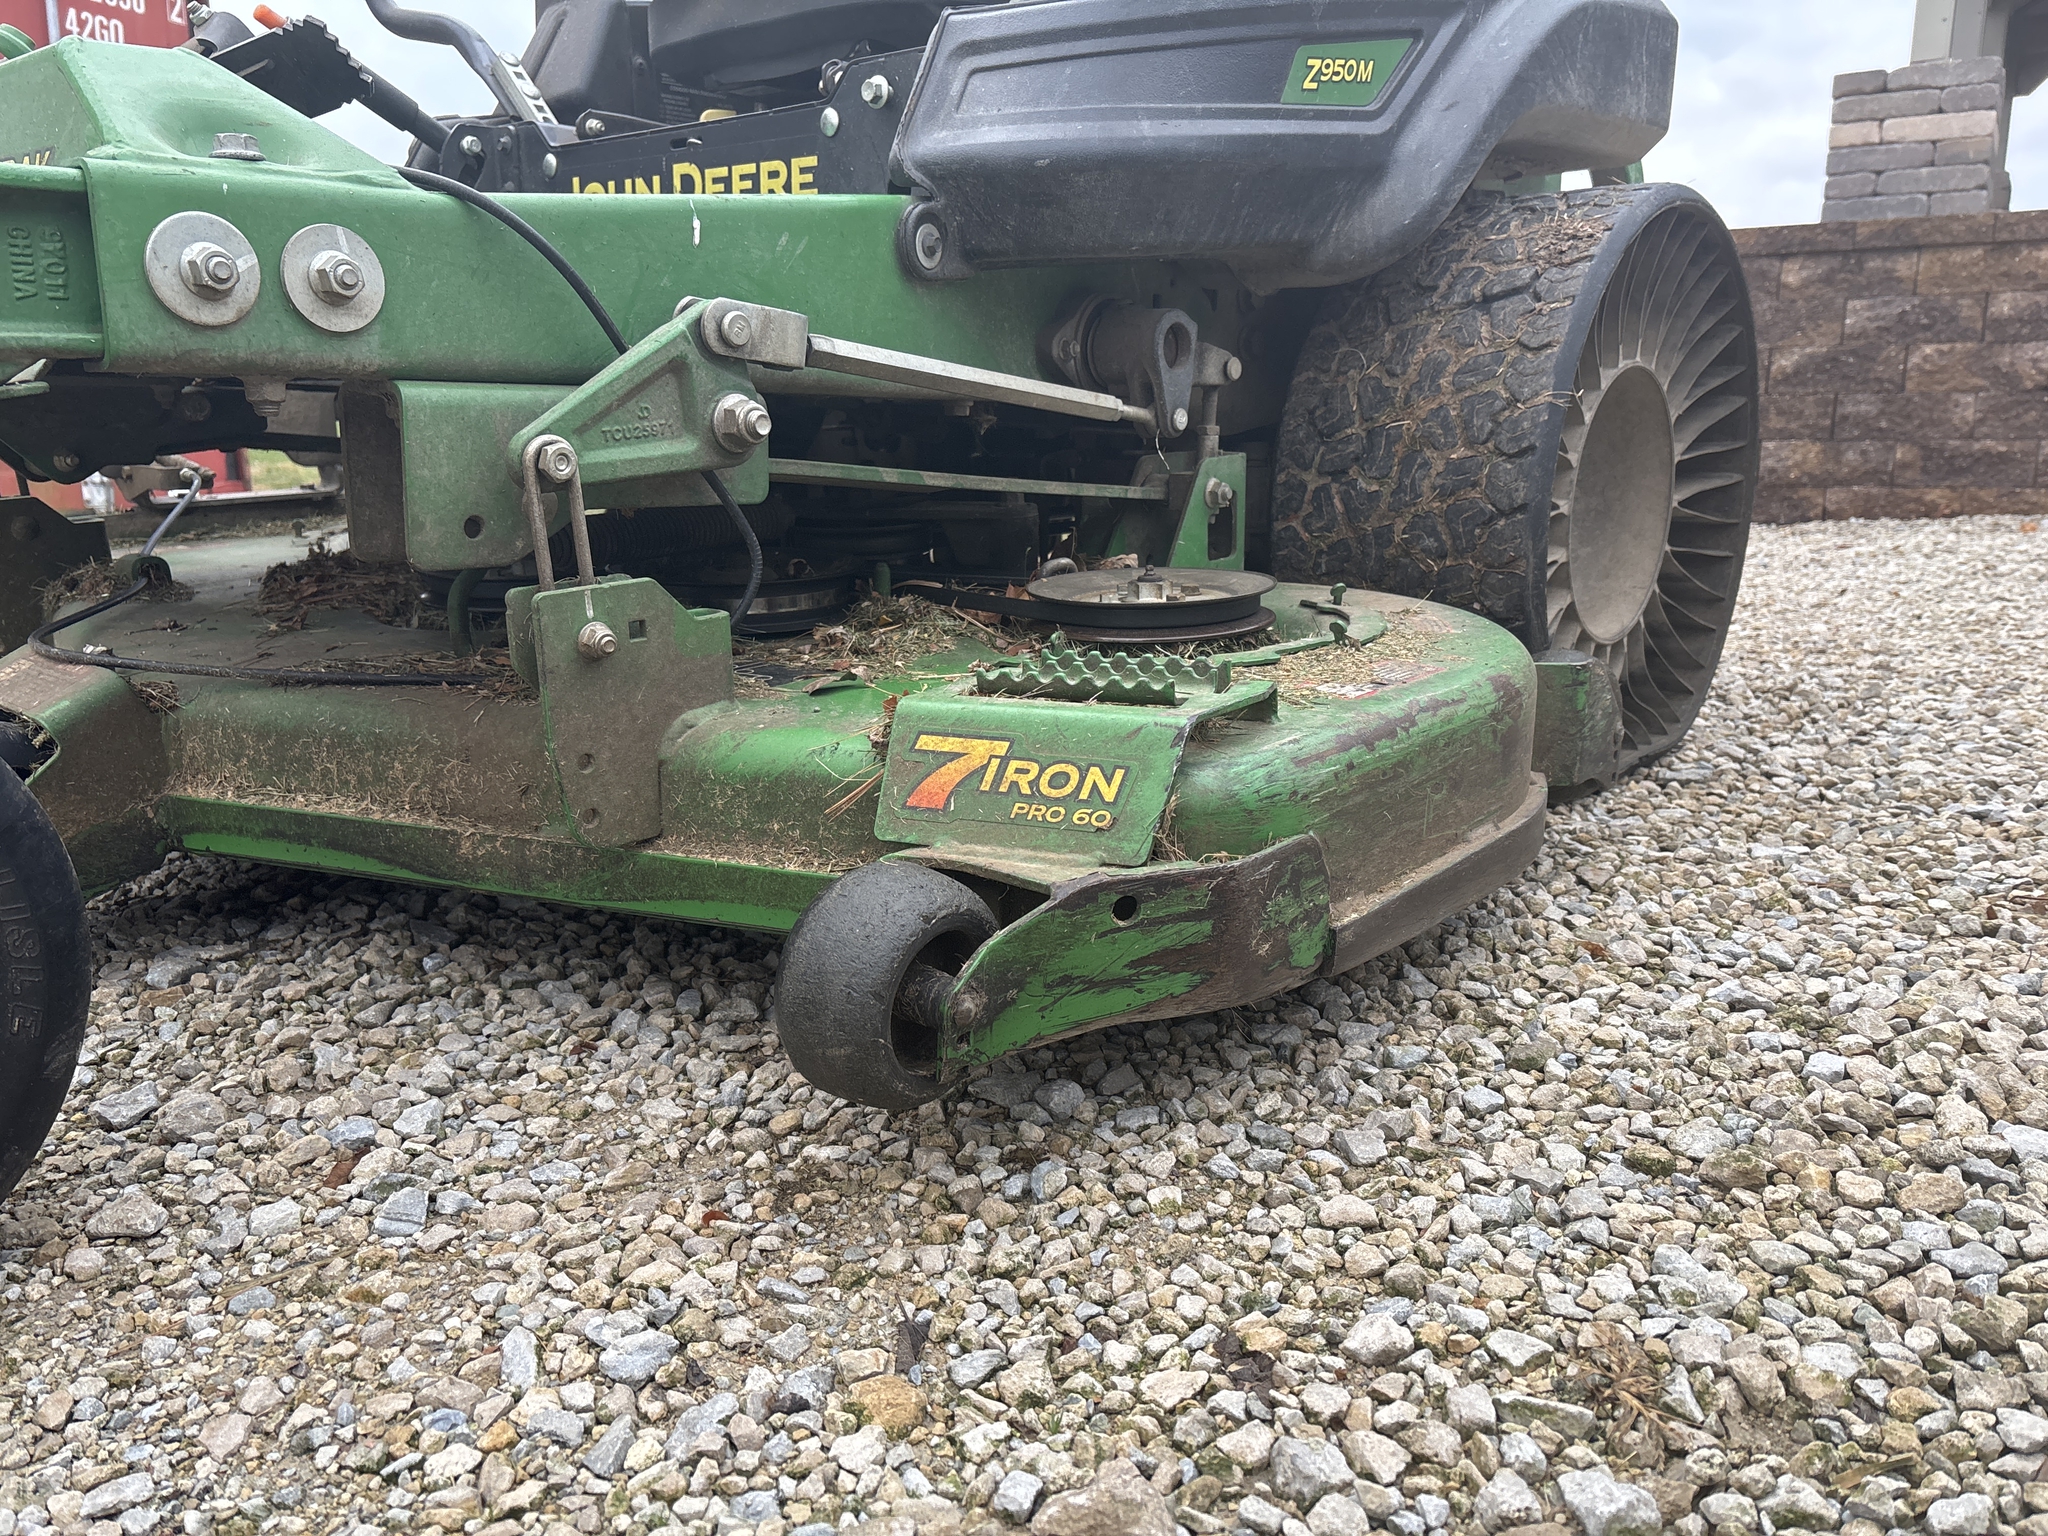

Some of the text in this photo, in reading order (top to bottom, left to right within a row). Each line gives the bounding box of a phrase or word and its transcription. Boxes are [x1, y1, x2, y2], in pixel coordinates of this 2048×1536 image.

[1302, 57, 1375, 90] Z950M
[672, 156, 818, 194] DEERE
[8, 227, 38, 300] CHINA
[1009, 802, 1112, 828] PRO 60
